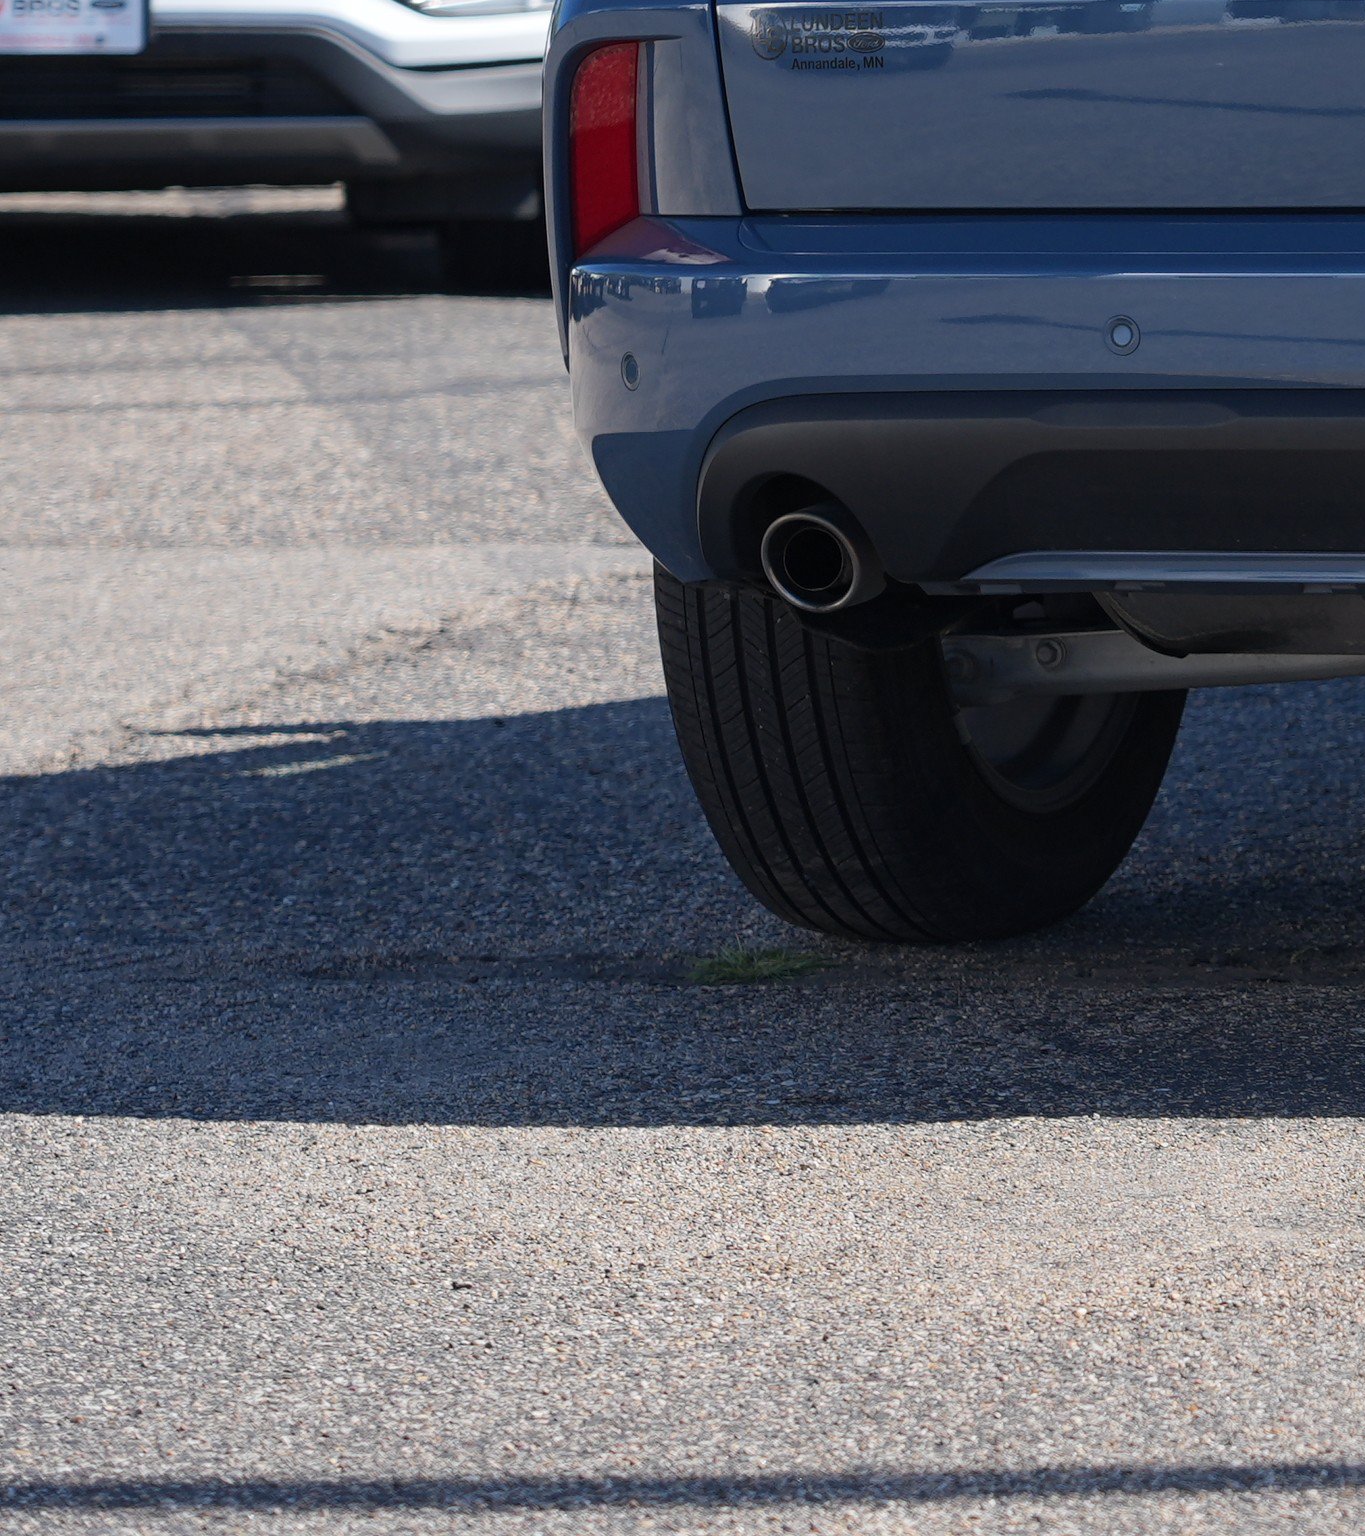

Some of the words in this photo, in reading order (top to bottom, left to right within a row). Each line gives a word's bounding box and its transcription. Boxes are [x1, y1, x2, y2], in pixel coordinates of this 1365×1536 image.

[790, 12, 883, 32] LUNDEEN
[791, 35, 846, 54] BROS
[791, 57, 860, 70] Annandale,
[863, 56, 884, 68] MN
